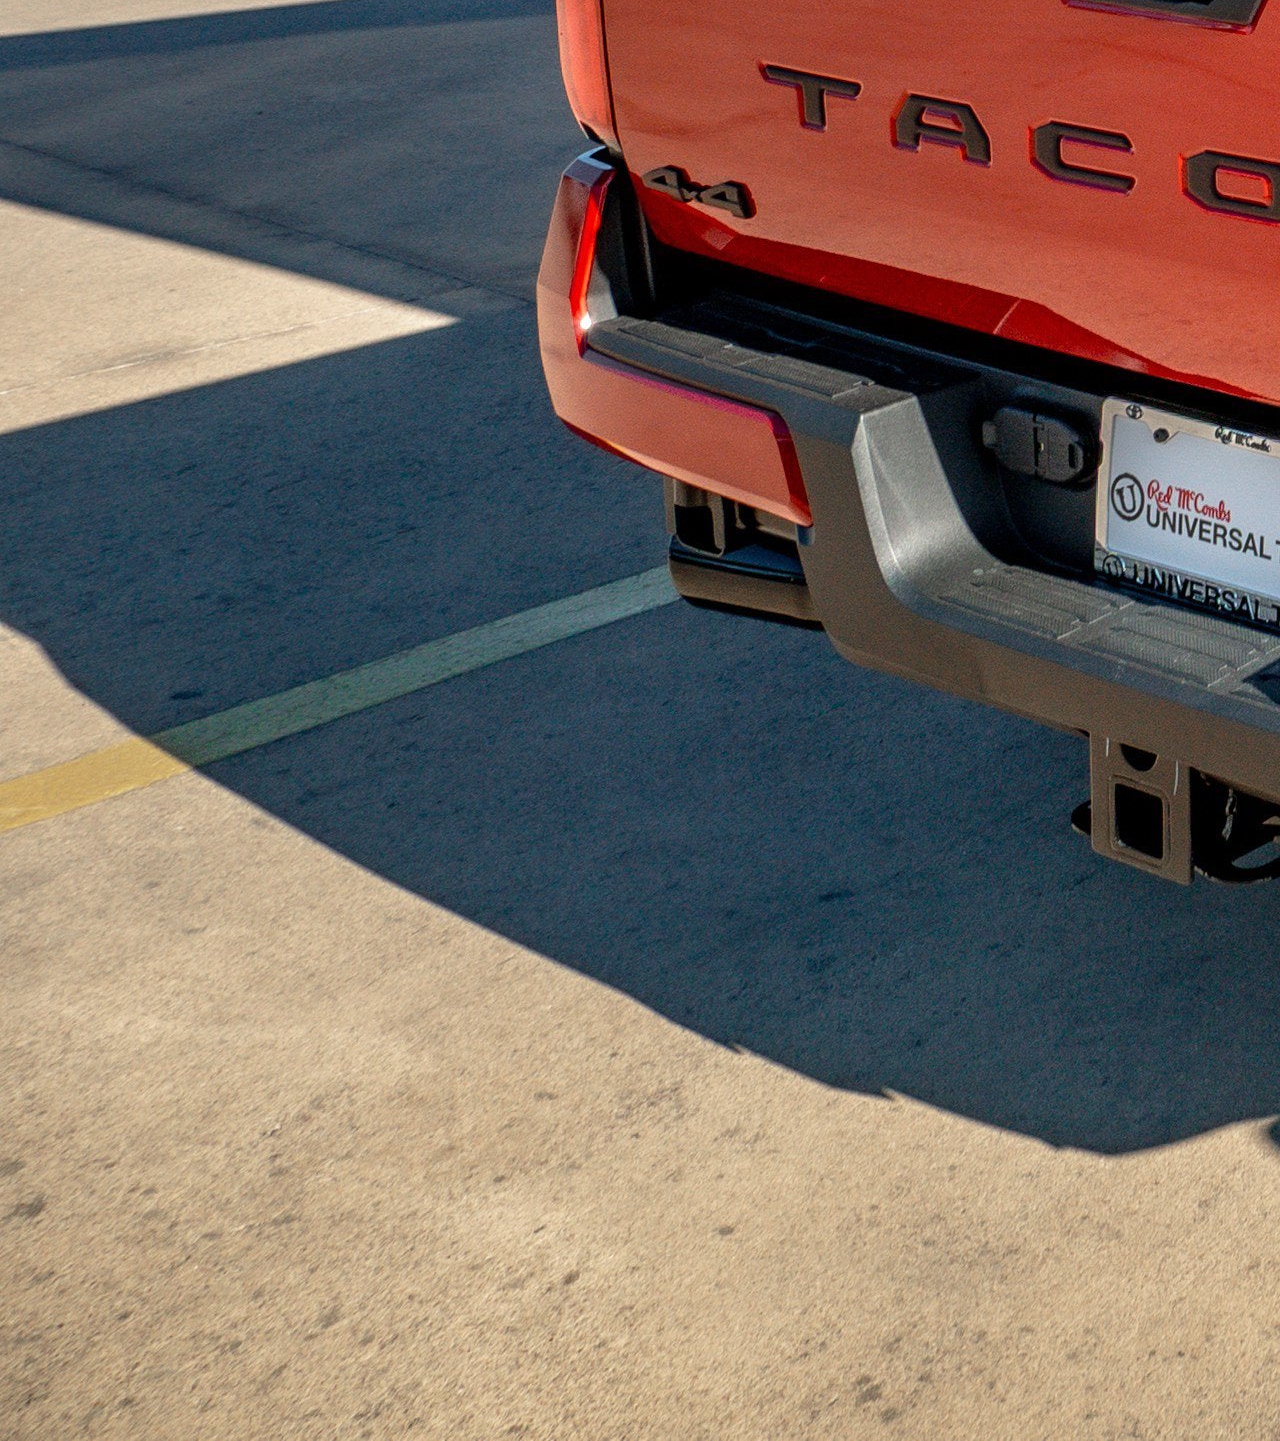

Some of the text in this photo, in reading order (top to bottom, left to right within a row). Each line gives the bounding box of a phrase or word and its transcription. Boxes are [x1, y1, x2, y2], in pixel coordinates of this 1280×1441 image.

[1147, 479, 1231, 523] Red McCombs
[1146, 504, 1272, 561] UNIVERSAL
[1132, 563, 1269, 623] UNIVERSAL
